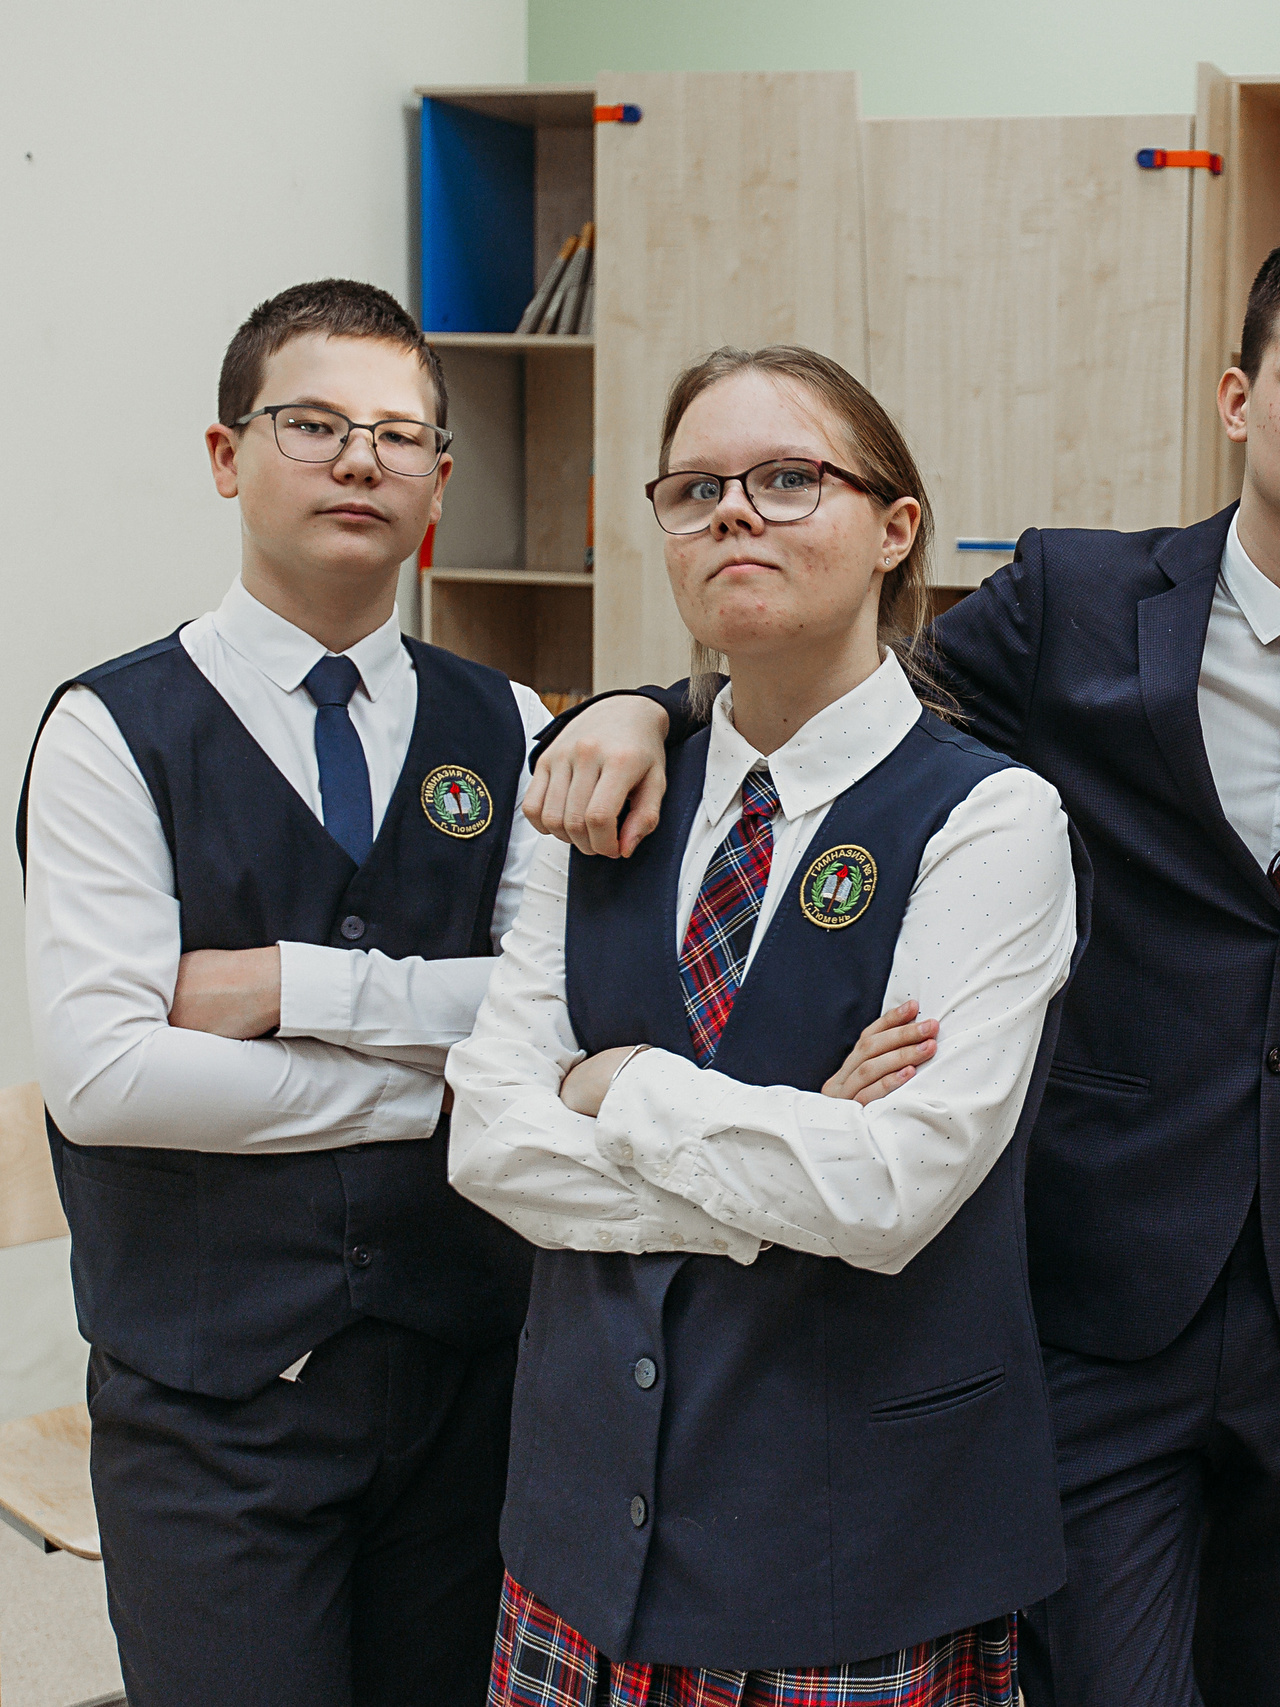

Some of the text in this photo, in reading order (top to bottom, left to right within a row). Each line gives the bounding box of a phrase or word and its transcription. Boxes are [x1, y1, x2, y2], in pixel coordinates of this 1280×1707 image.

[424, 769, 463, 803] ГИМНАЗИЯ
[450, 819, 486, 833] Тюмень
[810, 849, 873, 892] ГИМНАЗИЯ № 16
